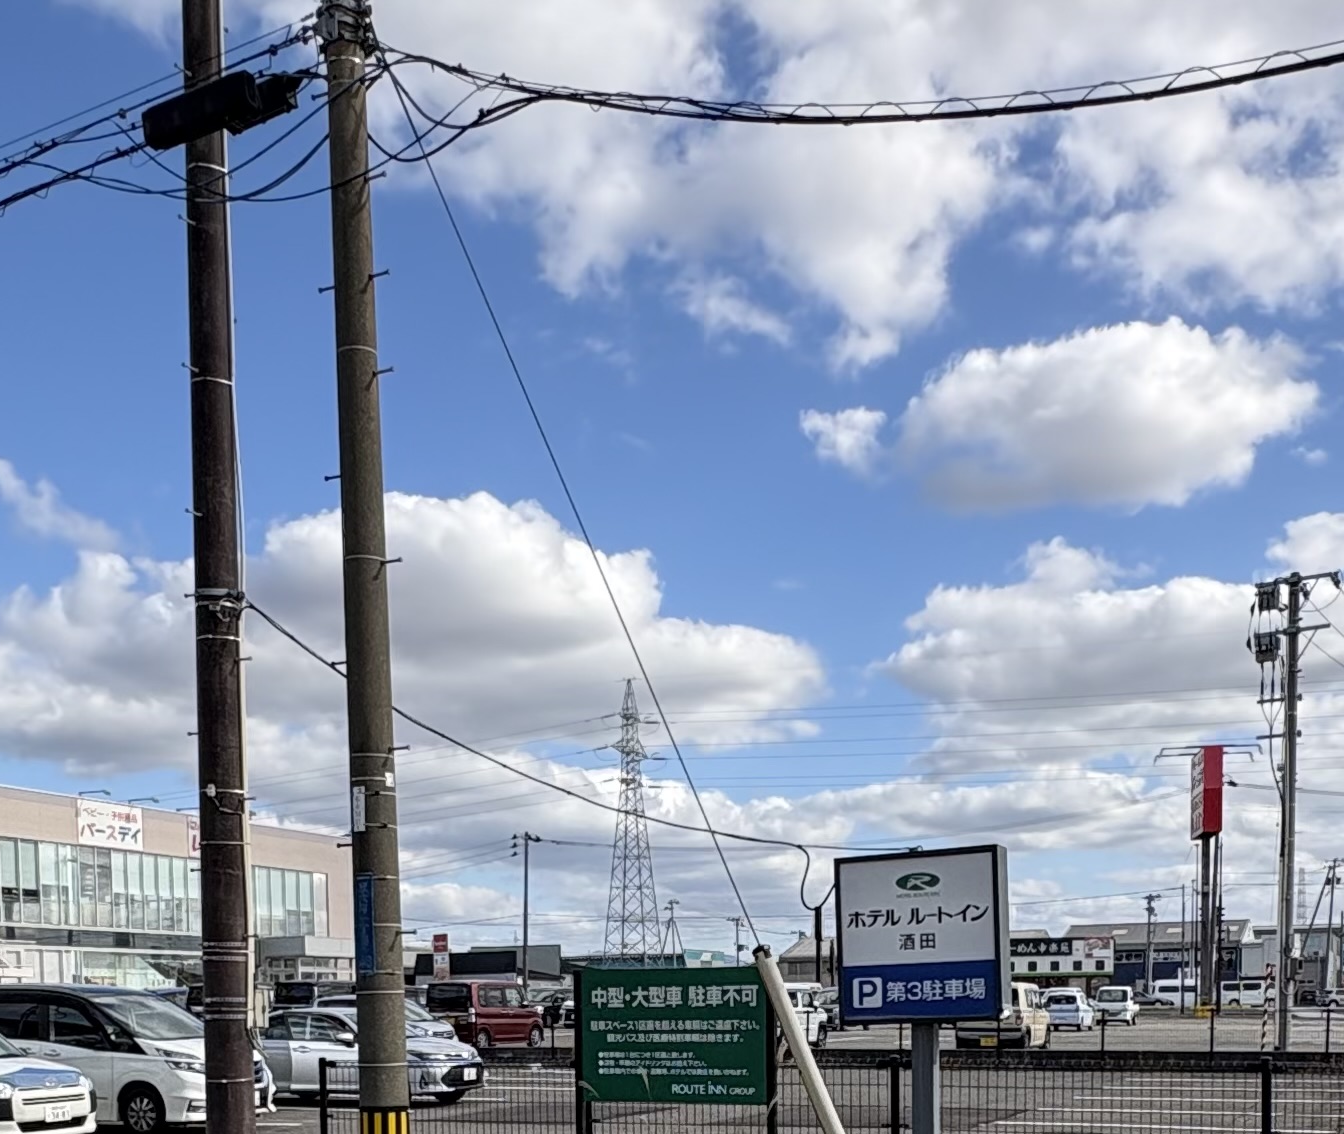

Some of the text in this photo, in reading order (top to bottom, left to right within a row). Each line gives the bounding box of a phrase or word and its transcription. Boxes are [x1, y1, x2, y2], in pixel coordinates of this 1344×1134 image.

[80, 823, 141, 843] バースデイ
[847, 904, 989, 929] ホテル ルートイン
[899, 933, 936, 950] 酒田
[591, 984, 759, 1009] 中型・大型車 駐車不可
[886, 978, 986, 1002] 第3駐車場
[671, 1083, 706, 1095] ROUTE
[729, 1087, 755, 1096] GROUP
